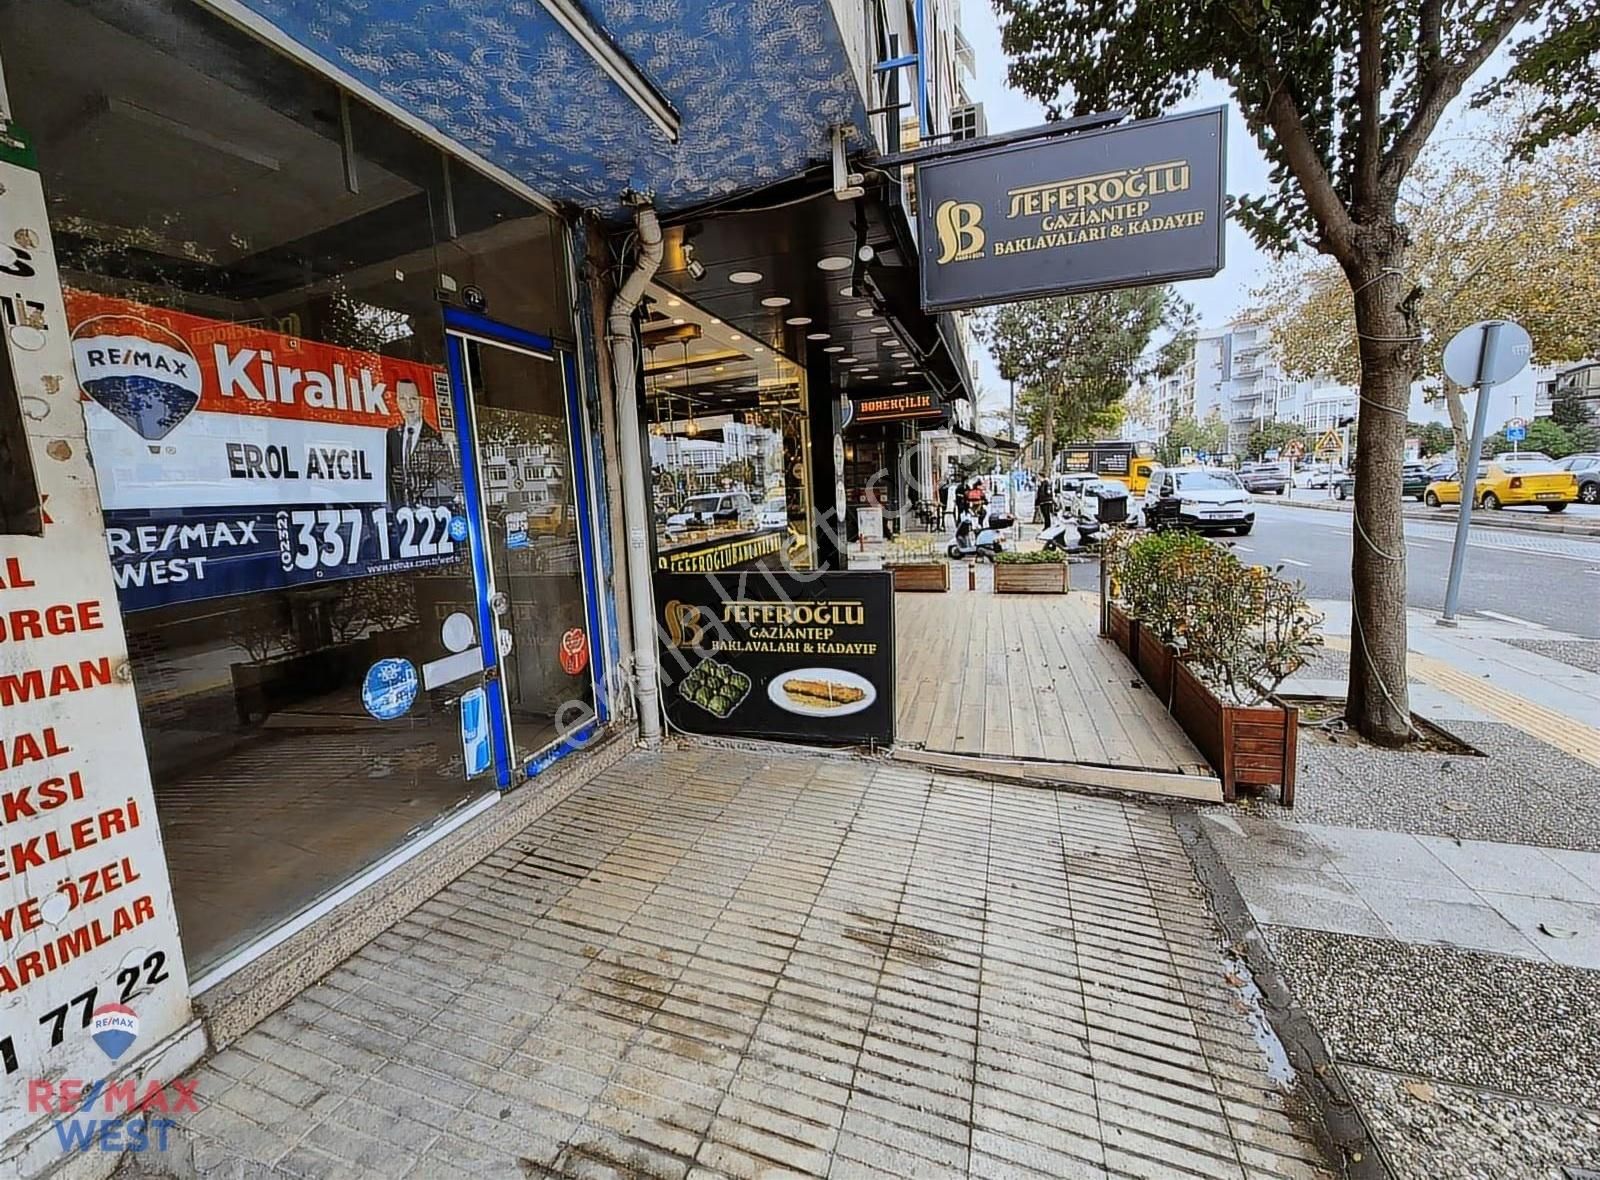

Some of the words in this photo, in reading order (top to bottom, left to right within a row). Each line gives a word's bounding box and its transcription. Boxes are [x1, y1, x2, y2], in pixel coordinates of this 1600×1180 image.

[1007, 160, 1189, 218] SEFEROĞLU
[993, 226, 1106, 255] BAKLAVALARI
[1110, 223, 1124, 238] &
[1127, 211, 1204, 235] KADAYIF
[1042, 201, 1150, 231] GAZİANTEP
[87, 348, 188, 378] RE/MAX
[213, 342, 390, 416] Kiralık
[226, 442, 299, 479] EROL
[106, 520, 259, 555] RE/MAX
[291, 509, 362, 569] 337
[372, 508, 390, 560] 1
[396, 505, 453, 558] 222
[0, 557, 35, 589] L
[112, 556, 207, 589] WEST
[720, 600, 864, 625] SEFEROĞLU
[711, 640, 800, 653] BAKLAVALARI
[803, 643, 814, 654] &
[817, 643, 877, 655] KADAYIF
[750, 624, 834, 640] GAZİANTEP
[0, 771, 84, 826] KSI
[117, 951, 169, 1005] 22
